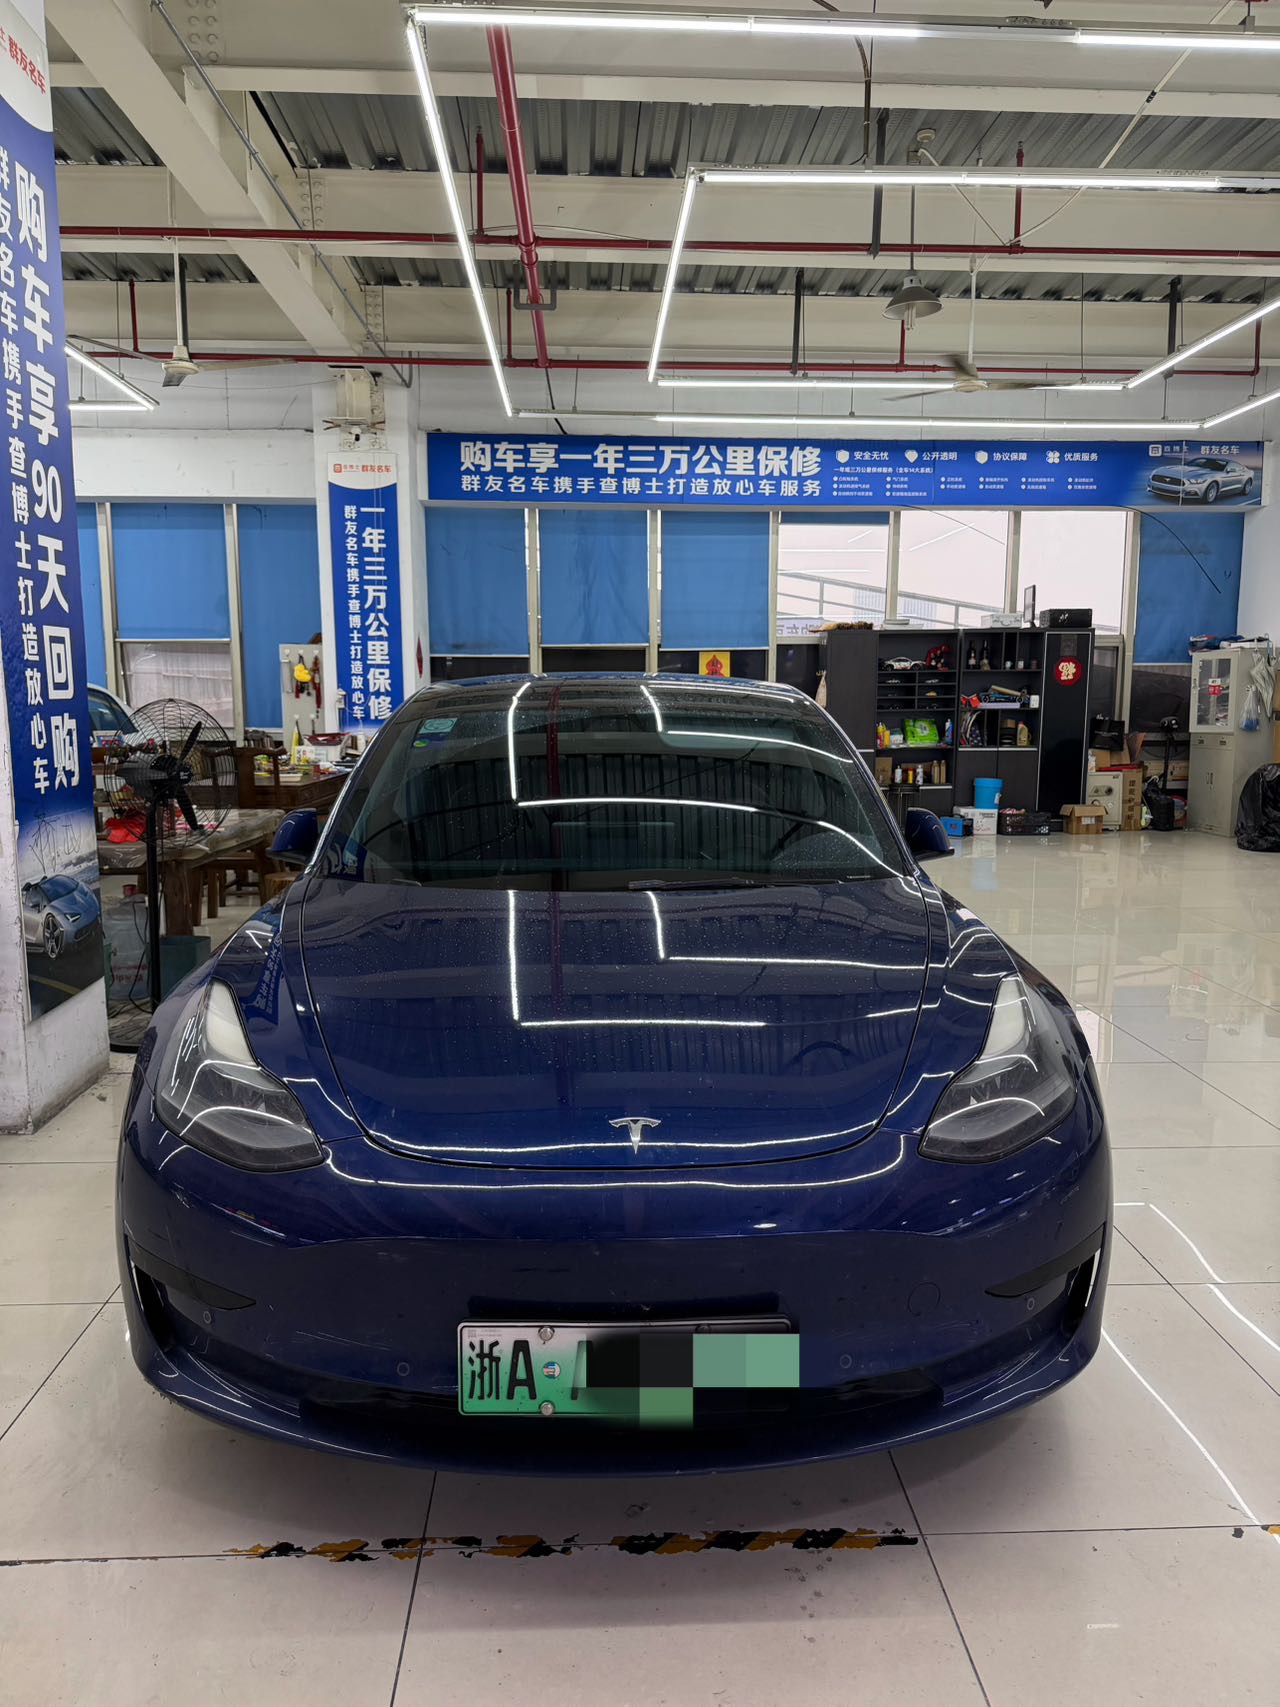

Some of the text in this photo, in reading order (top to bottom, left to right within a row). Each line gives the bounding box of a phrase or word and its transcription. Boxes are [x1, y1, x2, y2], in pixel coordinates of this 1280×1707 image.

[8, 34, 46, 95] 群友名车
[460, 441, 822, 477] 购车享一年三万公里保修
[853, 451, 889, 461] 安全无忧
[922, 451, 957, 461] 公开透明
[993, 452, 1027, 462] 协议保障
[1064, 452, 1099, 462] 优质服务
[1200, 445, 1240, 455] 群友名车
[15, 160, 80, 790] 购车享90天回购
[461, 475, 822, 497] 群友名车携手查博士打造放心车服务
[344, 505, 365, 720] 群友名车携手查博士打造放心车
[360, 507, 394, 720] 一年三万公里保修
